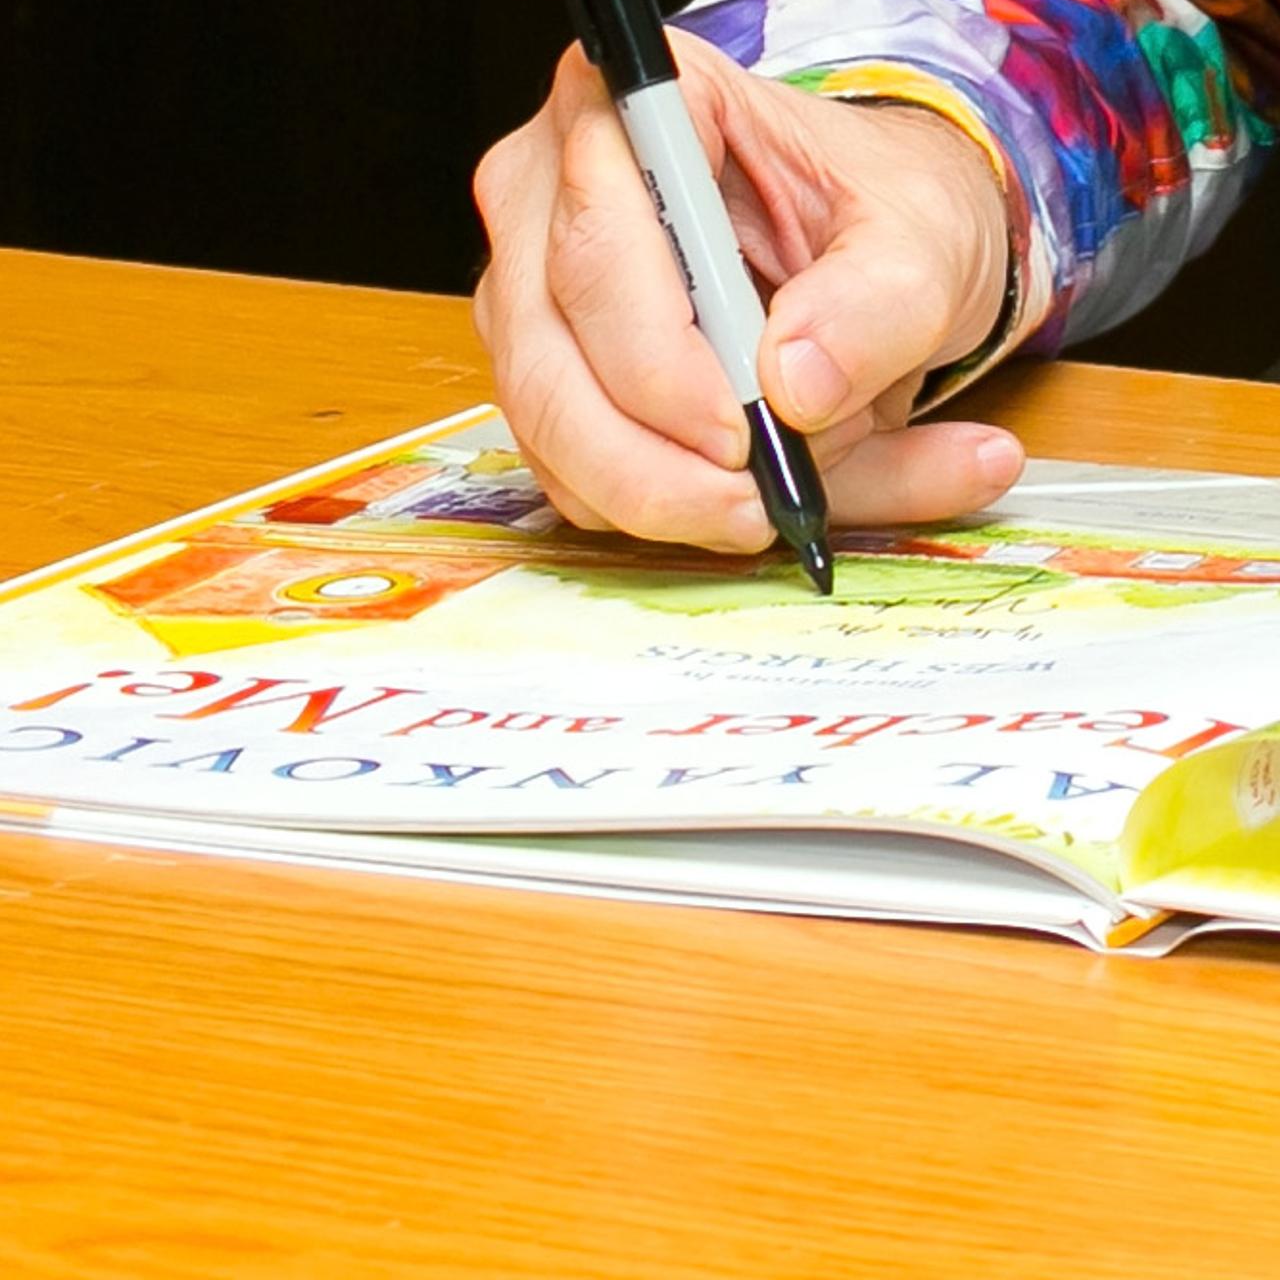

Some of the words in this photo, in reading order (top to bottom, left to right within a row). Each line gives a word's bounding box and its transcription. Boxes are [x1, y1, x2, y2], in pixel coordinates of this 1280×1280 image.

[634, 644, 903, 674] HARGIS
[920, 659, 1057, 676] WES
[9, 668, 427, 736] Me!
[379, 706, 624, 737] and
[645, 708, 1250, 760] Teacher
[0, 725, 830, 790] YANKOVIC
[938, 762, 1143, 801] AL
